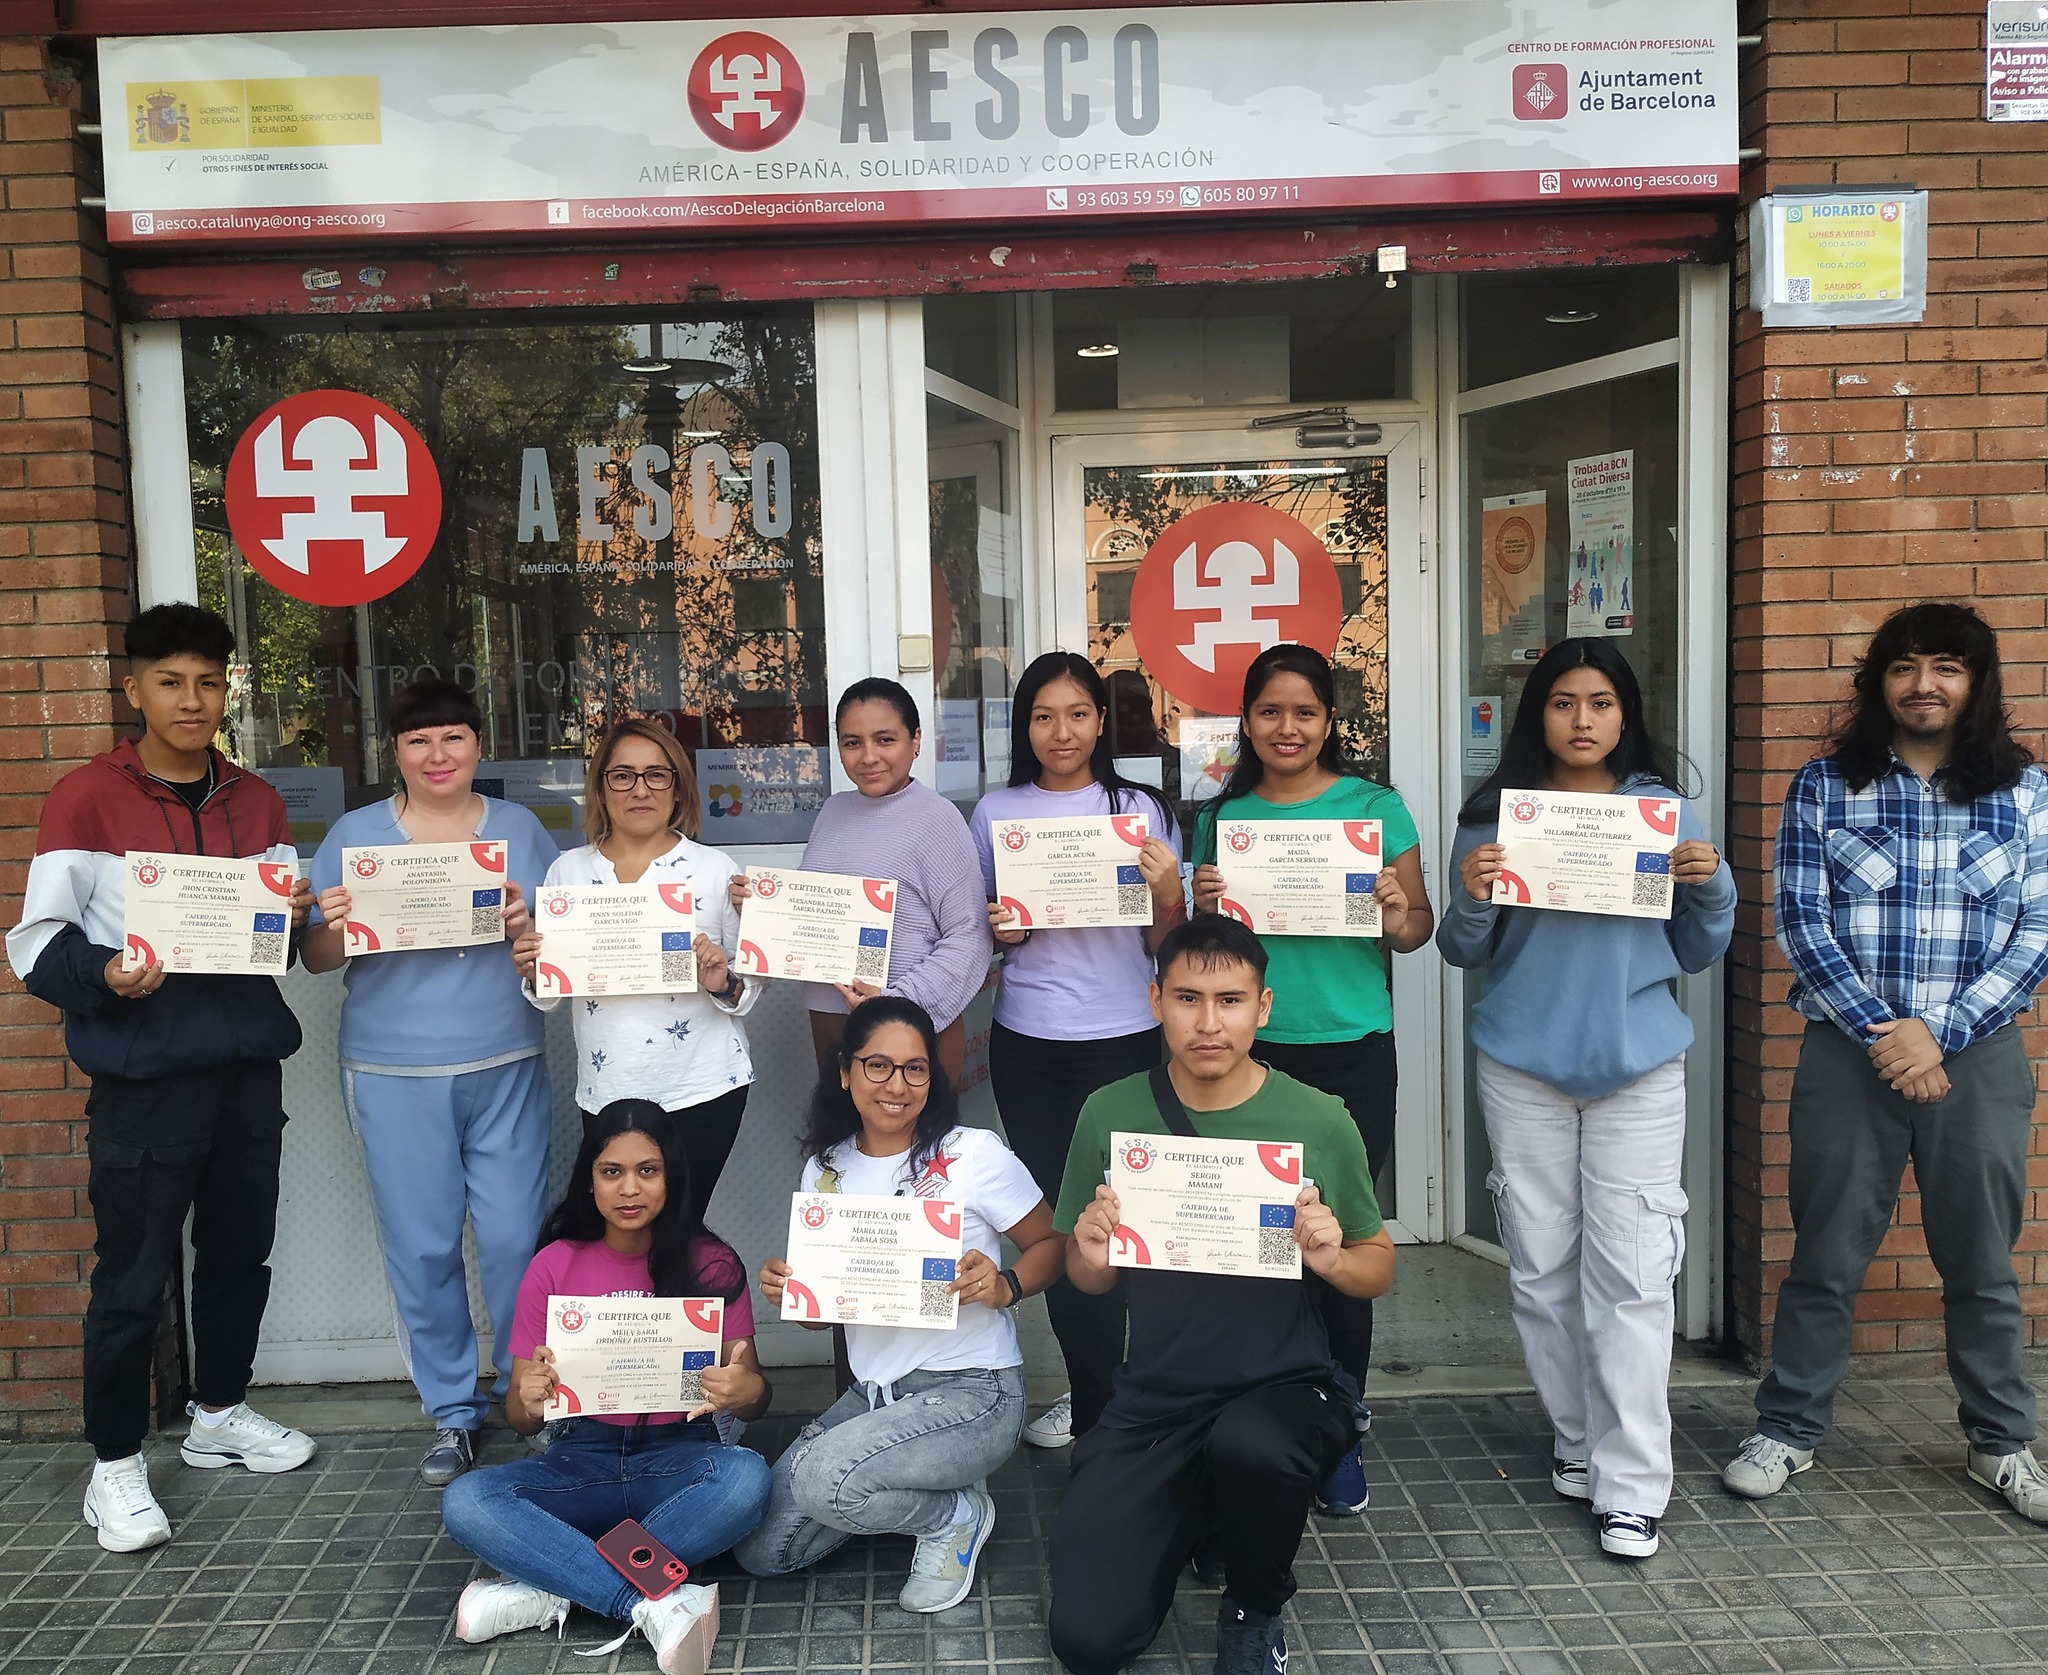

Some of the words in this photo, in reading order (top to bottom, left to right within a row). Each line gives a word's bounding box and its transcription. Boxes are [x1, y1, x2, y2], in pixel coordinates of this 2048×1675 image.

[1993, 22, 2048, 32] verisur
[1508, 44, 1552, 53] CENTRO
[1555, 43, 1568, 51] DE
[1571, 39, 1637, 51] FORMACIÓN
[1640, 38, 1715, 49] PROFESIONAL
[1992, 50, 2048, 65] Alarm
[840, 24, 1159, 144] AESCO
[1579, 69, 1702, 92] Ajuntament
[1992, 87, 2017, 95] Aviso
[1580, 95, 1604, 111] de
[1611, 91, 1715, 111] Barcelona
[200, 105, 238, 114] GOBIERNO
[251, 104, 293, 113] MINISTERIO
[212, 115, 240, 125] ESPAÑA
[251, 115, 260, 124] DE
[263, 115, 299, 124] SANIDAD,
[301, 113, 338, 123] SERVICIOS
[339, 112, 374, 122] SOCIALES
[252, 125, 256, 133] E
[258, 124, 297, 134] IGUALDAD
[202, 155, 216, 163] POR
[218, 153, 269, 162] SOLIDARIDAD
[860, 155, 1010, 178] SOLIDARIDAD
[1019, 156, 1031, 172] Y
[1042, 148, 1214, 173] COOPERACIÓN
[202, 165, 229, 173] OTROS
[231, 164, 253, 172] FINES
[255, 163, 264, 171] DE
[266, 162, 298, 171] INTERÉS
[300, 161, 328, 170] SOCIAL
[1572, 172, 1718, 188] www.ong-aesco.org
[1078, 192, 1097, 207] 93
[1100, 191, 1131, 207] 603
[1134, 190, 1153, 206] 59
[1156, 189, 1175, 205] 59
[1204, 187, 1231, 203] 605
[1236, 186, 1255, 202] 80
[1258, 185, 1279, 202] 97
[1282, 184, 1300, 201] 11
[582, 198, 885, 221] facebook.com/AescoDelegaciónBarcelona
[1812, 205, 1875, 217] HORARIO
[156, 212, 385, 231] aesco.catalunya@ong-aesco.org
[1574, 461, 1609, 475] Trobada
[1611, 458, 1627, 469] BCN
[1572, 477, 1597, 488] Ciutat
[1600, 472, 1630, 484] Diversa
[517, 442, 794, 543] AESCO
[520, 562, 573, 573] AMÉRICA,
[1210, 734, 1239, 742] ENTR
[1551, 806, 1601, 816] CERTIFICA
[1605, 809, 1625, 819] QUE
[1037, 830, 1082, 839] CERTIFICA
[1084, 829, 1101, 837] QUE
[1313, 834, 1332, 842] QUE
[1544, 829, 1588, 838] VILLARREAL
[1590, 833, 1632, 841] GUTIERREZ
[1563, 851, 1597, 859] CAJERO/A
[391, 857, 438, 866] CERTIFICA
[1557, 858, 1612, 866] SUPERMERCADO
[173, 869, 223, 879] CERTIFICA
[789, 883, 833, 893] CERTIFICA
[835, 888, 851, 896] QUE
[582, 896, 627, 904] CERTIFICA
[630, 896, 648, 904] QUE
[788, 898, 825, 907] ALEXANDRA
[817, 908, 846, 916] PAZMIÑO
[798, 925, 826, 933] CAJERO/A
[793, 931, 839, 940] SUPERMERCADO
[1165, 1153, 1218, 1163] CERTIFICA
[1222, 1156, 1244, 1165] QUE
[1191, 1172, 1220, 1180] SERGIO
[1188, 1181, 1222, 1189] MAMANI
[1181, 1203, 1217, 1212] CAJERO/A
[839, 1210, 888, 1220] CERTIFICA
[891, 1212, 911, 1222] QUE
[1176, 1211, 1234, 1221] SUPERMERCADO
[852, 1227, 875, 1235] MARIA
[845, 1266, 899, 1275] SUPERMERCADO
[611, 1290, 644, 1298] DESIRE
